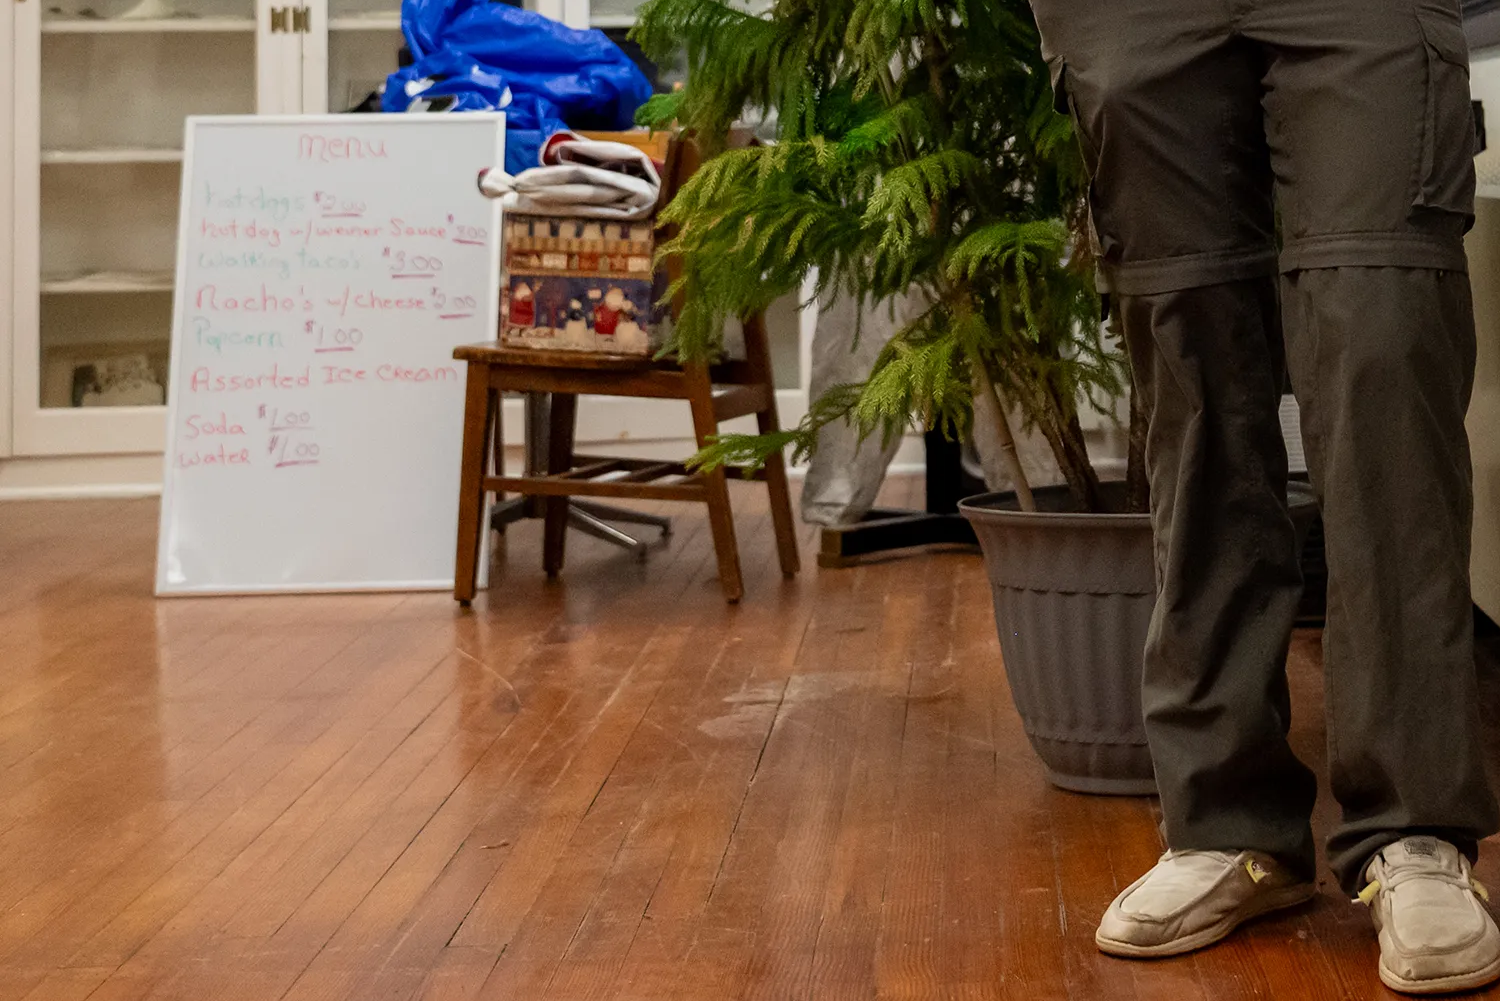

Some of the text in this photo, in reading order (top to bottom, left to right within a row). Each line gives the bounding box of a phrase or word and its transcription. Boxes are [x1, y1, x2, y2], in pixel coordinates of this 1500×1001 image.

[190, 362, 310, 393] Assorted
[321, 365, 367, 385] Ice
[184, 411, 247, 440] Soda
